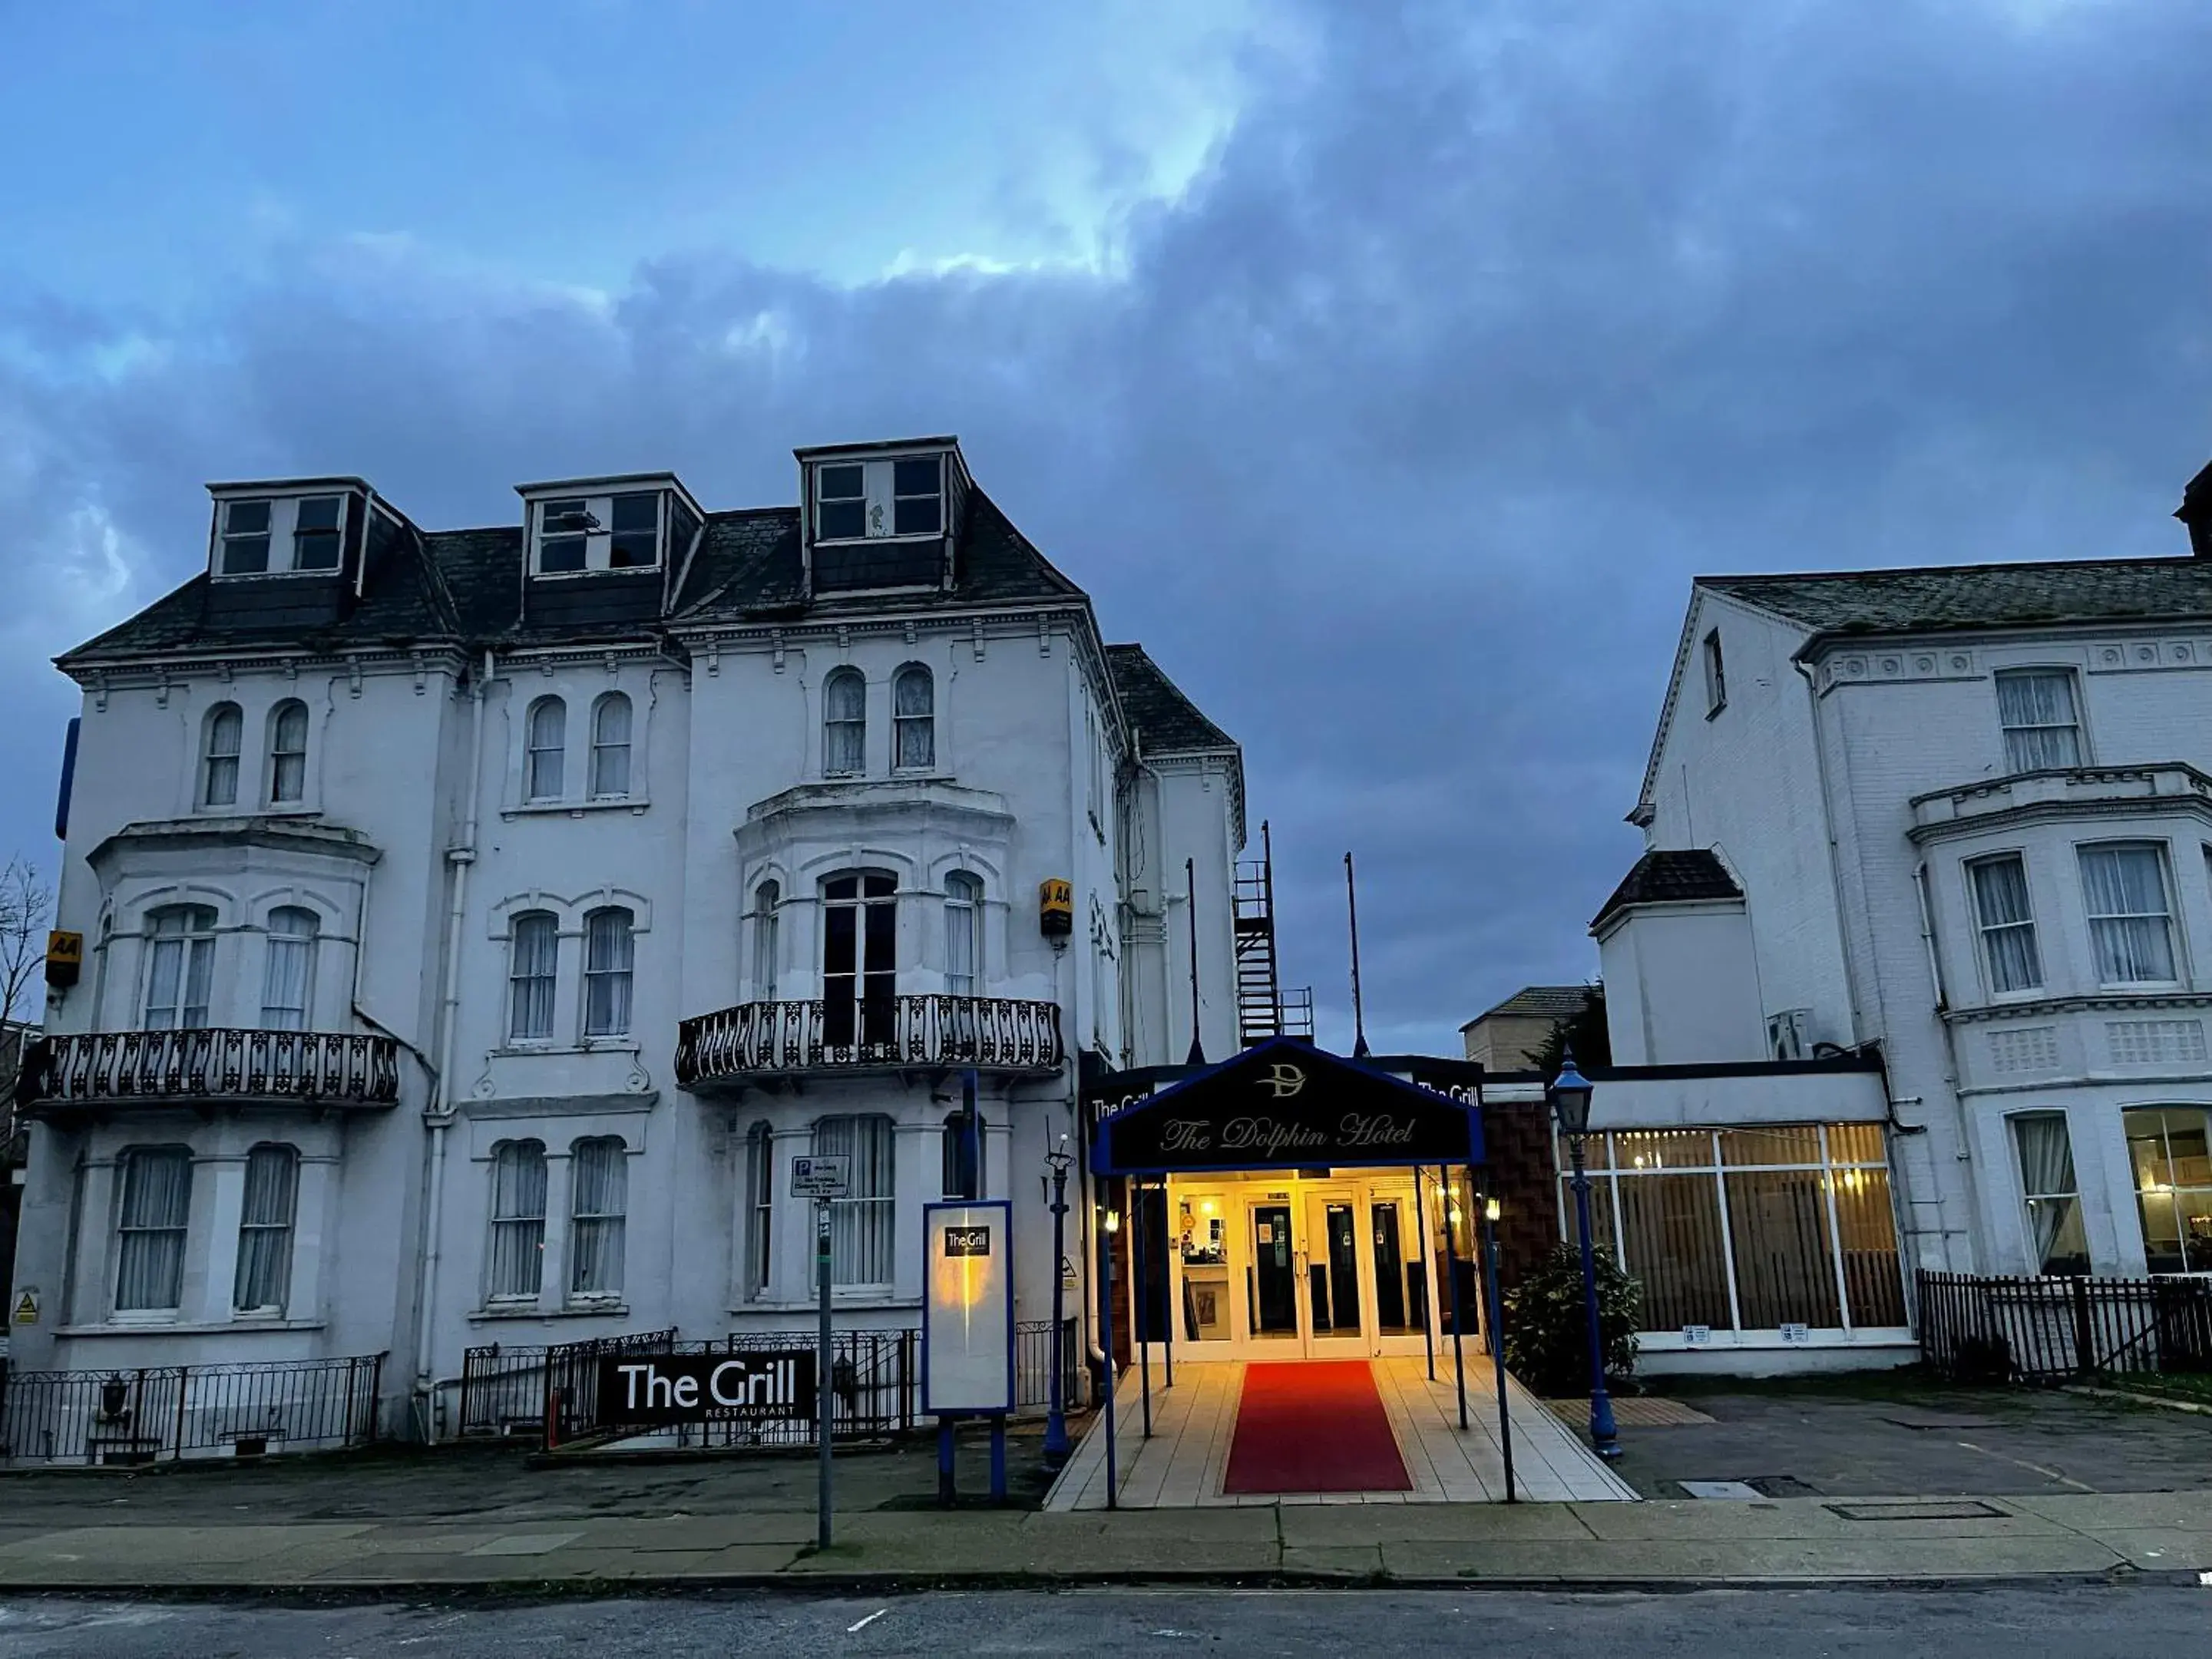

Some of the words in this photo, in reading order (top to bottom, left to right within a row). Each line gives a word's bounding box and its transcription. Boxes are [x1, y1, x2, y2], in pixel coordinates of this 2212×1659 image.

[1055, 886, 1070, 905] AA
[51, 937, 78, 956] AA
[1160, 1119, 1211, 1151] The
[1218, 1117, 1328, 1158] Dolphin
[1336, 1112, 1416, 1146] Hotel
[799, 1162, 808, 1175] P
[948, 1233, 966, 1247] The
[967, 1232, 986, 1246] Grill
[617, 1364, 699, 1409] The
[710, 1359, 795, 1406] Grill
[706, 1406, 795, 1418] RESTAURANT
